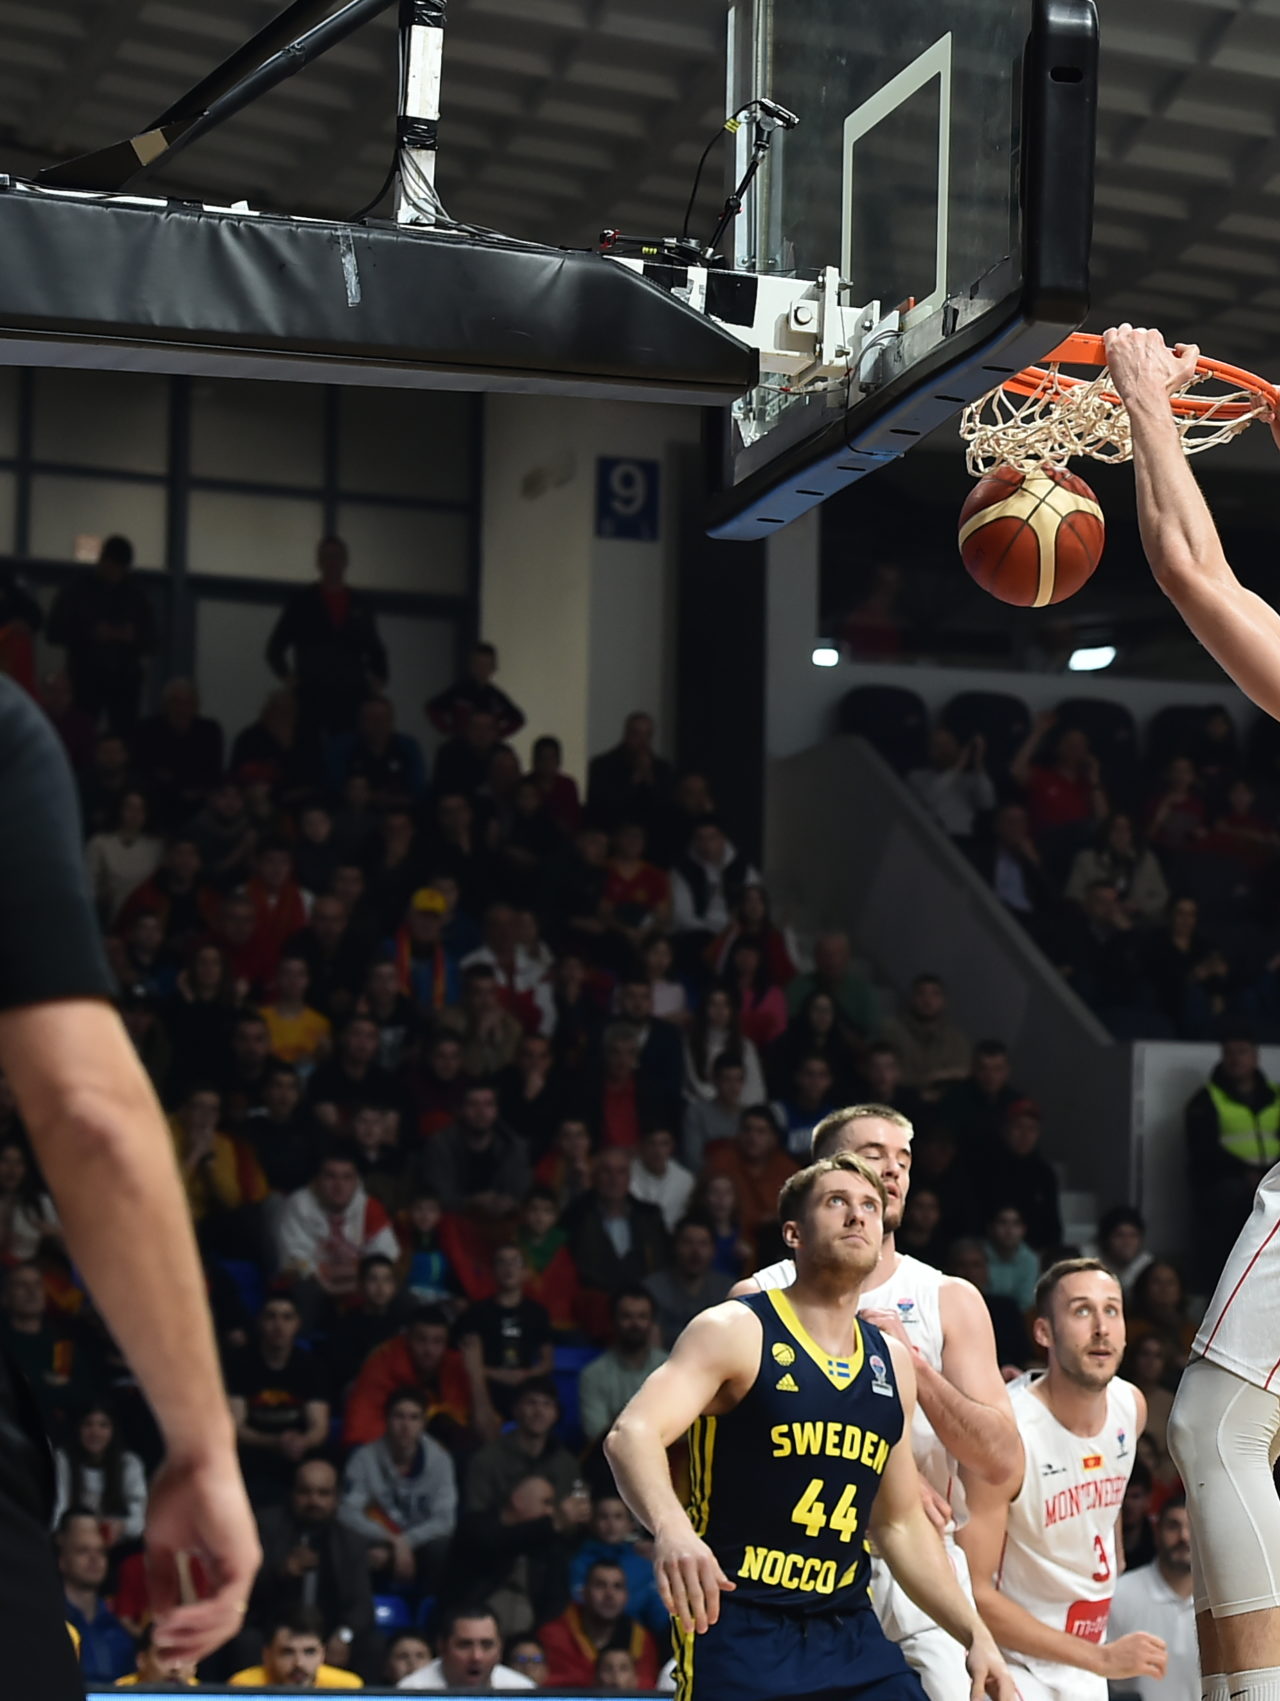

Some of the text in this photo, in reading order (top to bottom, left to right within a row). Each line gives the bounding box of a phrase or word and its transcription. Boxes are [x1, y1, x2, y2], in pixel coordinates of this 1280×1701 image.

[609, 463, 648, 516] 9
[770, 1421, 890, 1475] SWEDEN
[791, 1478, 858, 1543] 44
[737, 1545, 837, 1595] NOCCO
[1092, 1535, 1110, 1583] 3
